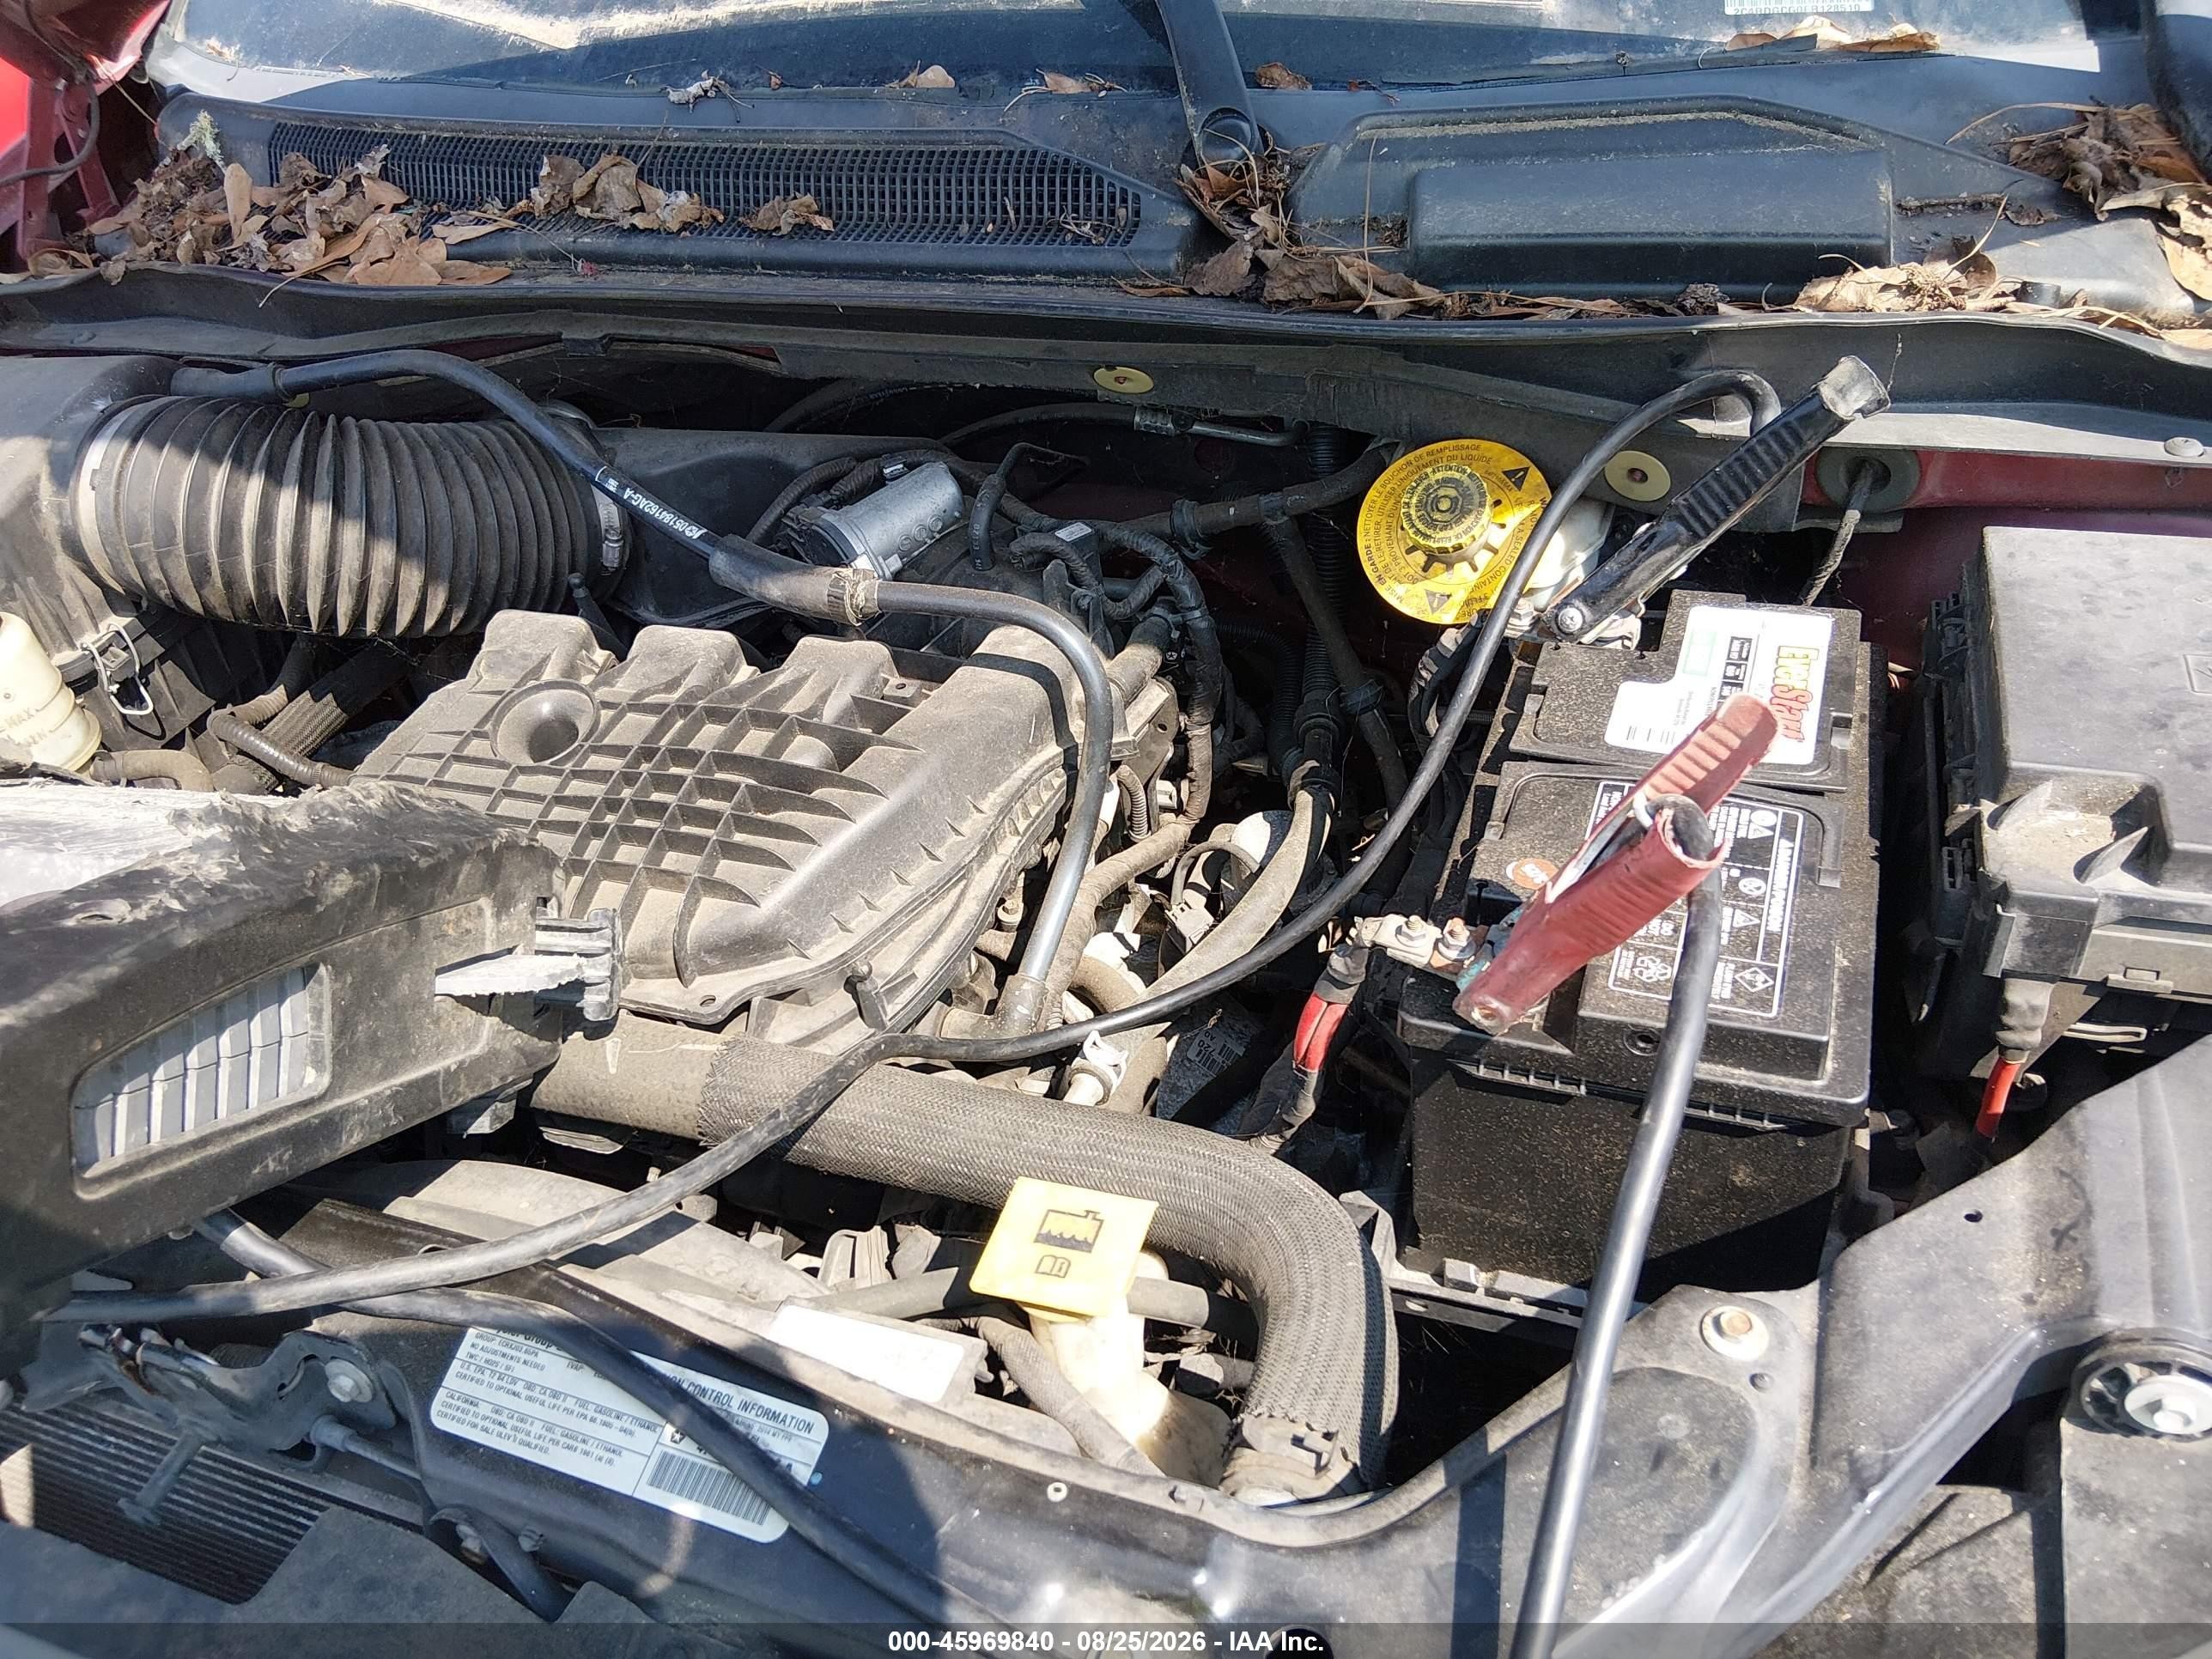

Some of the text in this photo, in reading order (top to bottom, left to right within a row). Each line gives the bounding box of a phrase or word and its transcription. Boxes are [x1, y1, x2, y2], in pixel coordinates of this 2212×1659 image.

[1413, 453, 1425, 464] DE
[1425, 444, 1482, 458] REMPLISSAGE
[1376, 487, 1397, 517] UTILISER
[1397, 457, 1444, 487] UNIQUEMENT
[1446, 453, 1459, 462] DU
[1460, 453, 1493, 465] LIQUIDE
[1380, 459, 1413, 492] BOUCHON
[623, 488, 689, 532] 05184162AG-A
[1373, 489, 1382, 502] LE
[1364, 499, 1377, 536] NETTOYER
[1364, 544, 1379, 573] GARDE
[1383, 521, 1401, 567] PROVENANT
[1504, 536, 1523, 565] SEALED
[1376, 574, 1387, 586] EN
[1769, 646, 1819, 741] EverStart
[480, 1346, 520, 1363] ADJUSTMENTS
[522, 1359, 545, 1370] NEEDED
[455, 1371, 485, 1385] CERTIFIED
[495, 1385, 523, 1398] OPTIONAL
[525, 1395, 546, 1407] USEFUL
[549, 1402, 561, 1411] LIFE
[436, 1410, 466, 1425] CERTIFIED
[466, 1420, 478, 1429] FOR
[480, 1425, 495, 1434] SALE
[594, 1406, 623, 1420] GASOLINE
[630, 1418, 659, 1431] ETHANOL
[685, 1382, 737, 1407] CONTROL
[737, 1399, 815, 1434] INFORMATION
[441, 1401, 471, 1415] CERTIFIED
[481, 1414, 509, 1428] OPTIONAL
[510, 1425, 532, 1437] USEFUL
[534, 1432, 546, 1441] LIFE
[549, 1437, 561, 1446] PER
[560, 1431, 589, 1444] GASOLINE
[596, 1443, 623, 1456] ETHANOL
